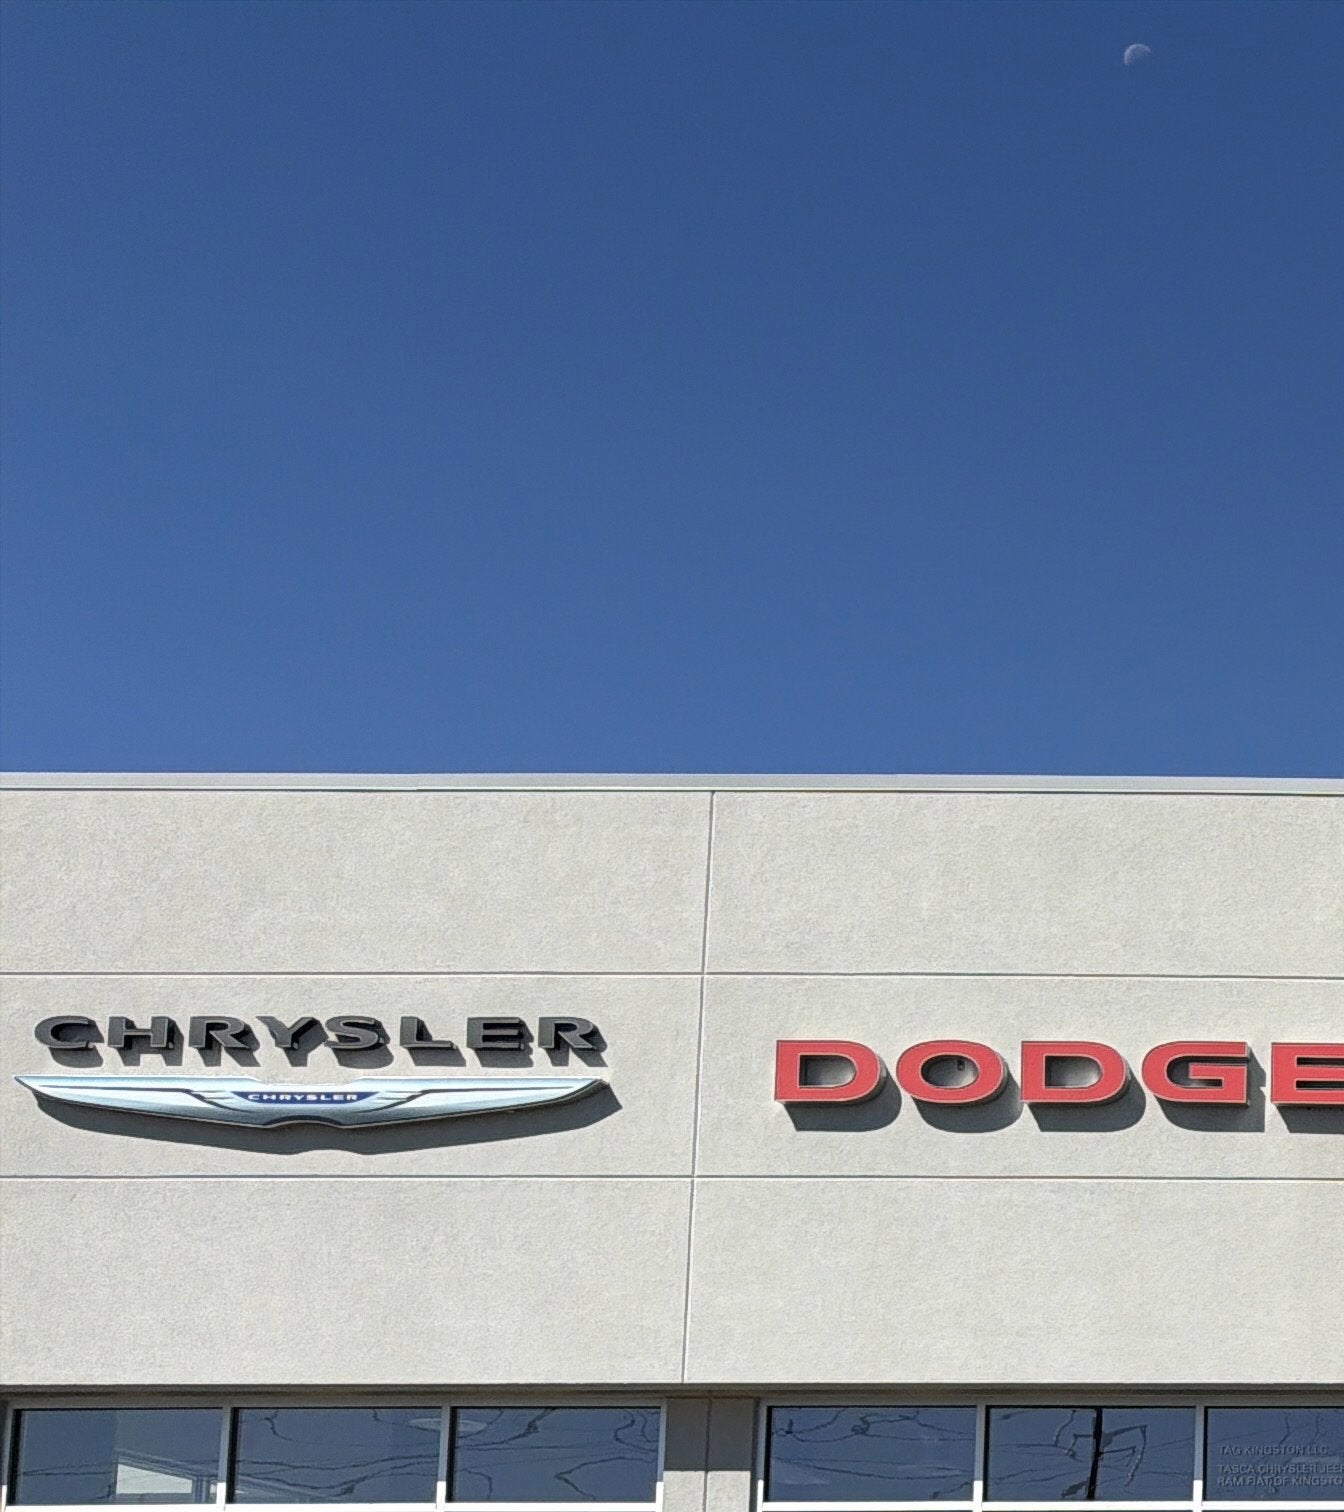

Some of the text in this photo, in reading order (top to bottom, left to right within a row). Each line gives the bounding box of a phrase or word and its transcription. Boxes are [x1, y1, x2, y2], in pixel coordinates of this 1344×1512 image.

[33, 1015, 602, 1051] CHRYSLER
[247, 1093, 359, 1101] CHRYSLER
[1219, 1445, 1329, 1455] TAG KINGSTON LLC
[1217, 1464, 1255, 1474] TASCA
[1258, 1464, 1317, 1474] CHRYSLER
[1216, 1476, 1244, 1487] RAM
[1248, 1476, 1270, 1487] FIAT
[1273, 1476, 1289, 1487] OF
